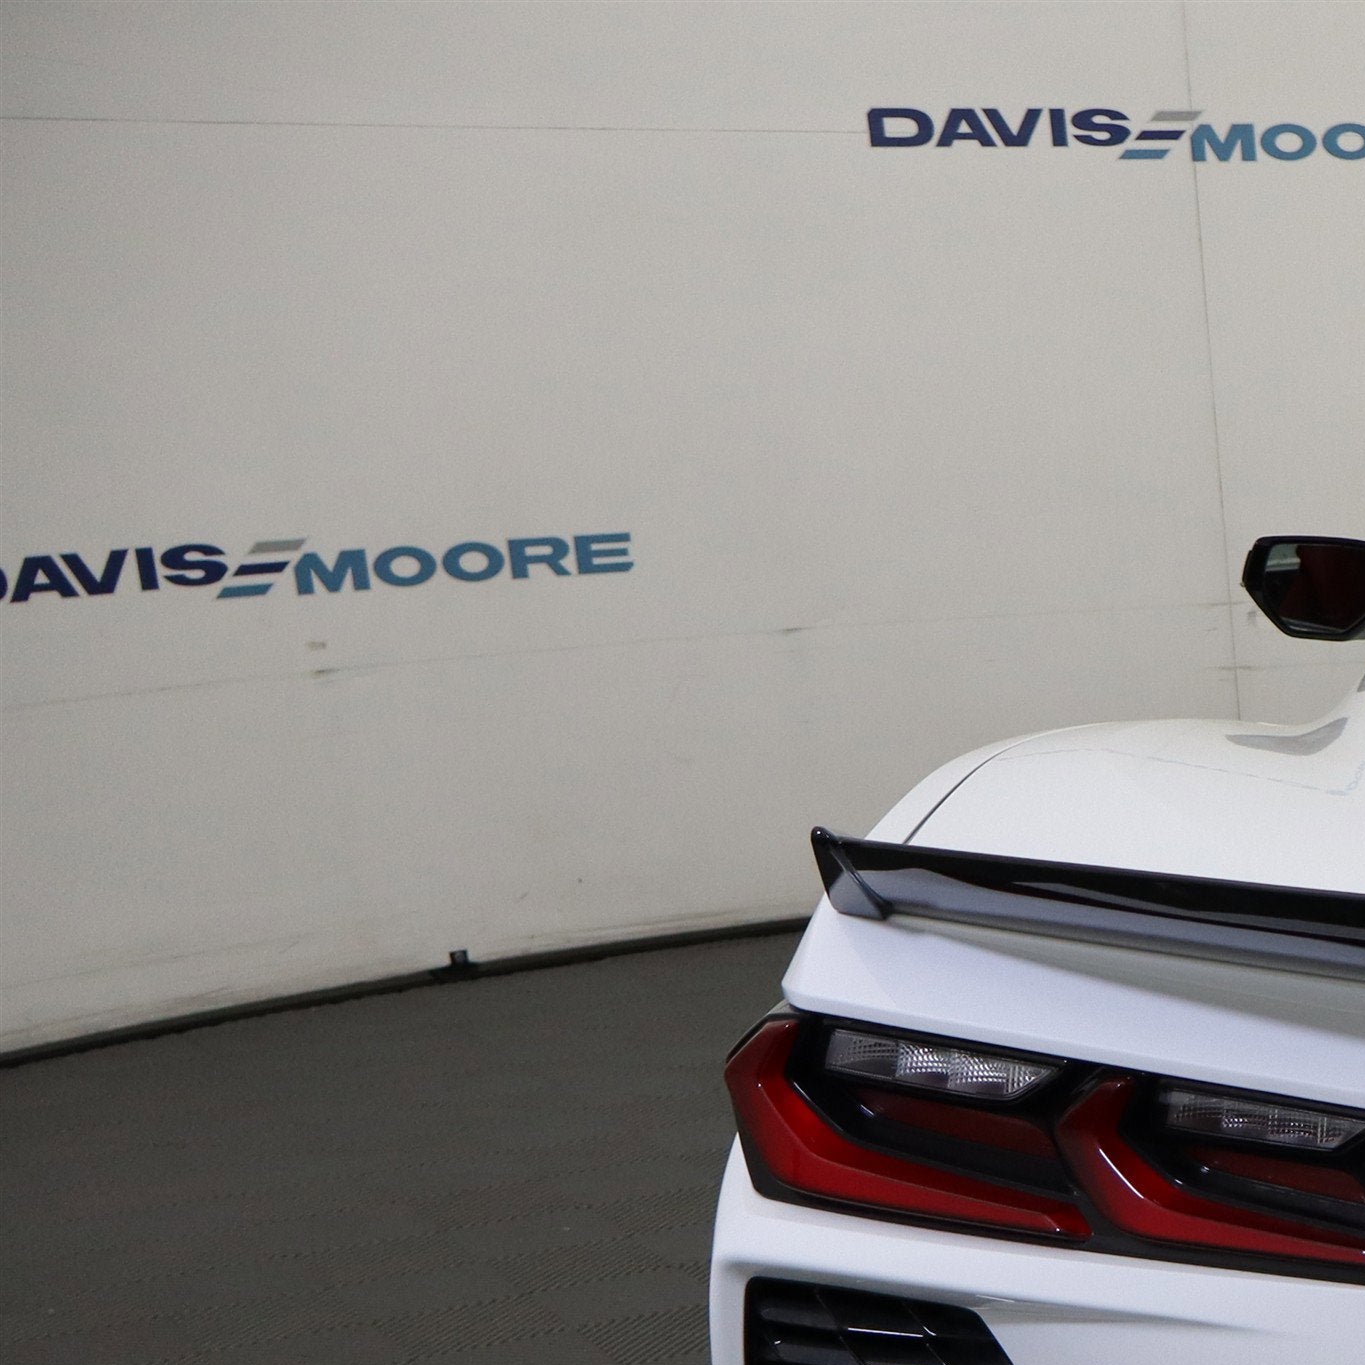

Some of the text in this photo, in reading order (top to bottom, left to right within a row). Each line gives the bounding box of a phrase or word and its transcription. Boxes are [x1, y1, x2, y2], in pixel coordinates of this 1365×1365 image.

[866, 107, 1132, 148] DAVIS
[0, 532, 634, 605] AVIS MOORE
